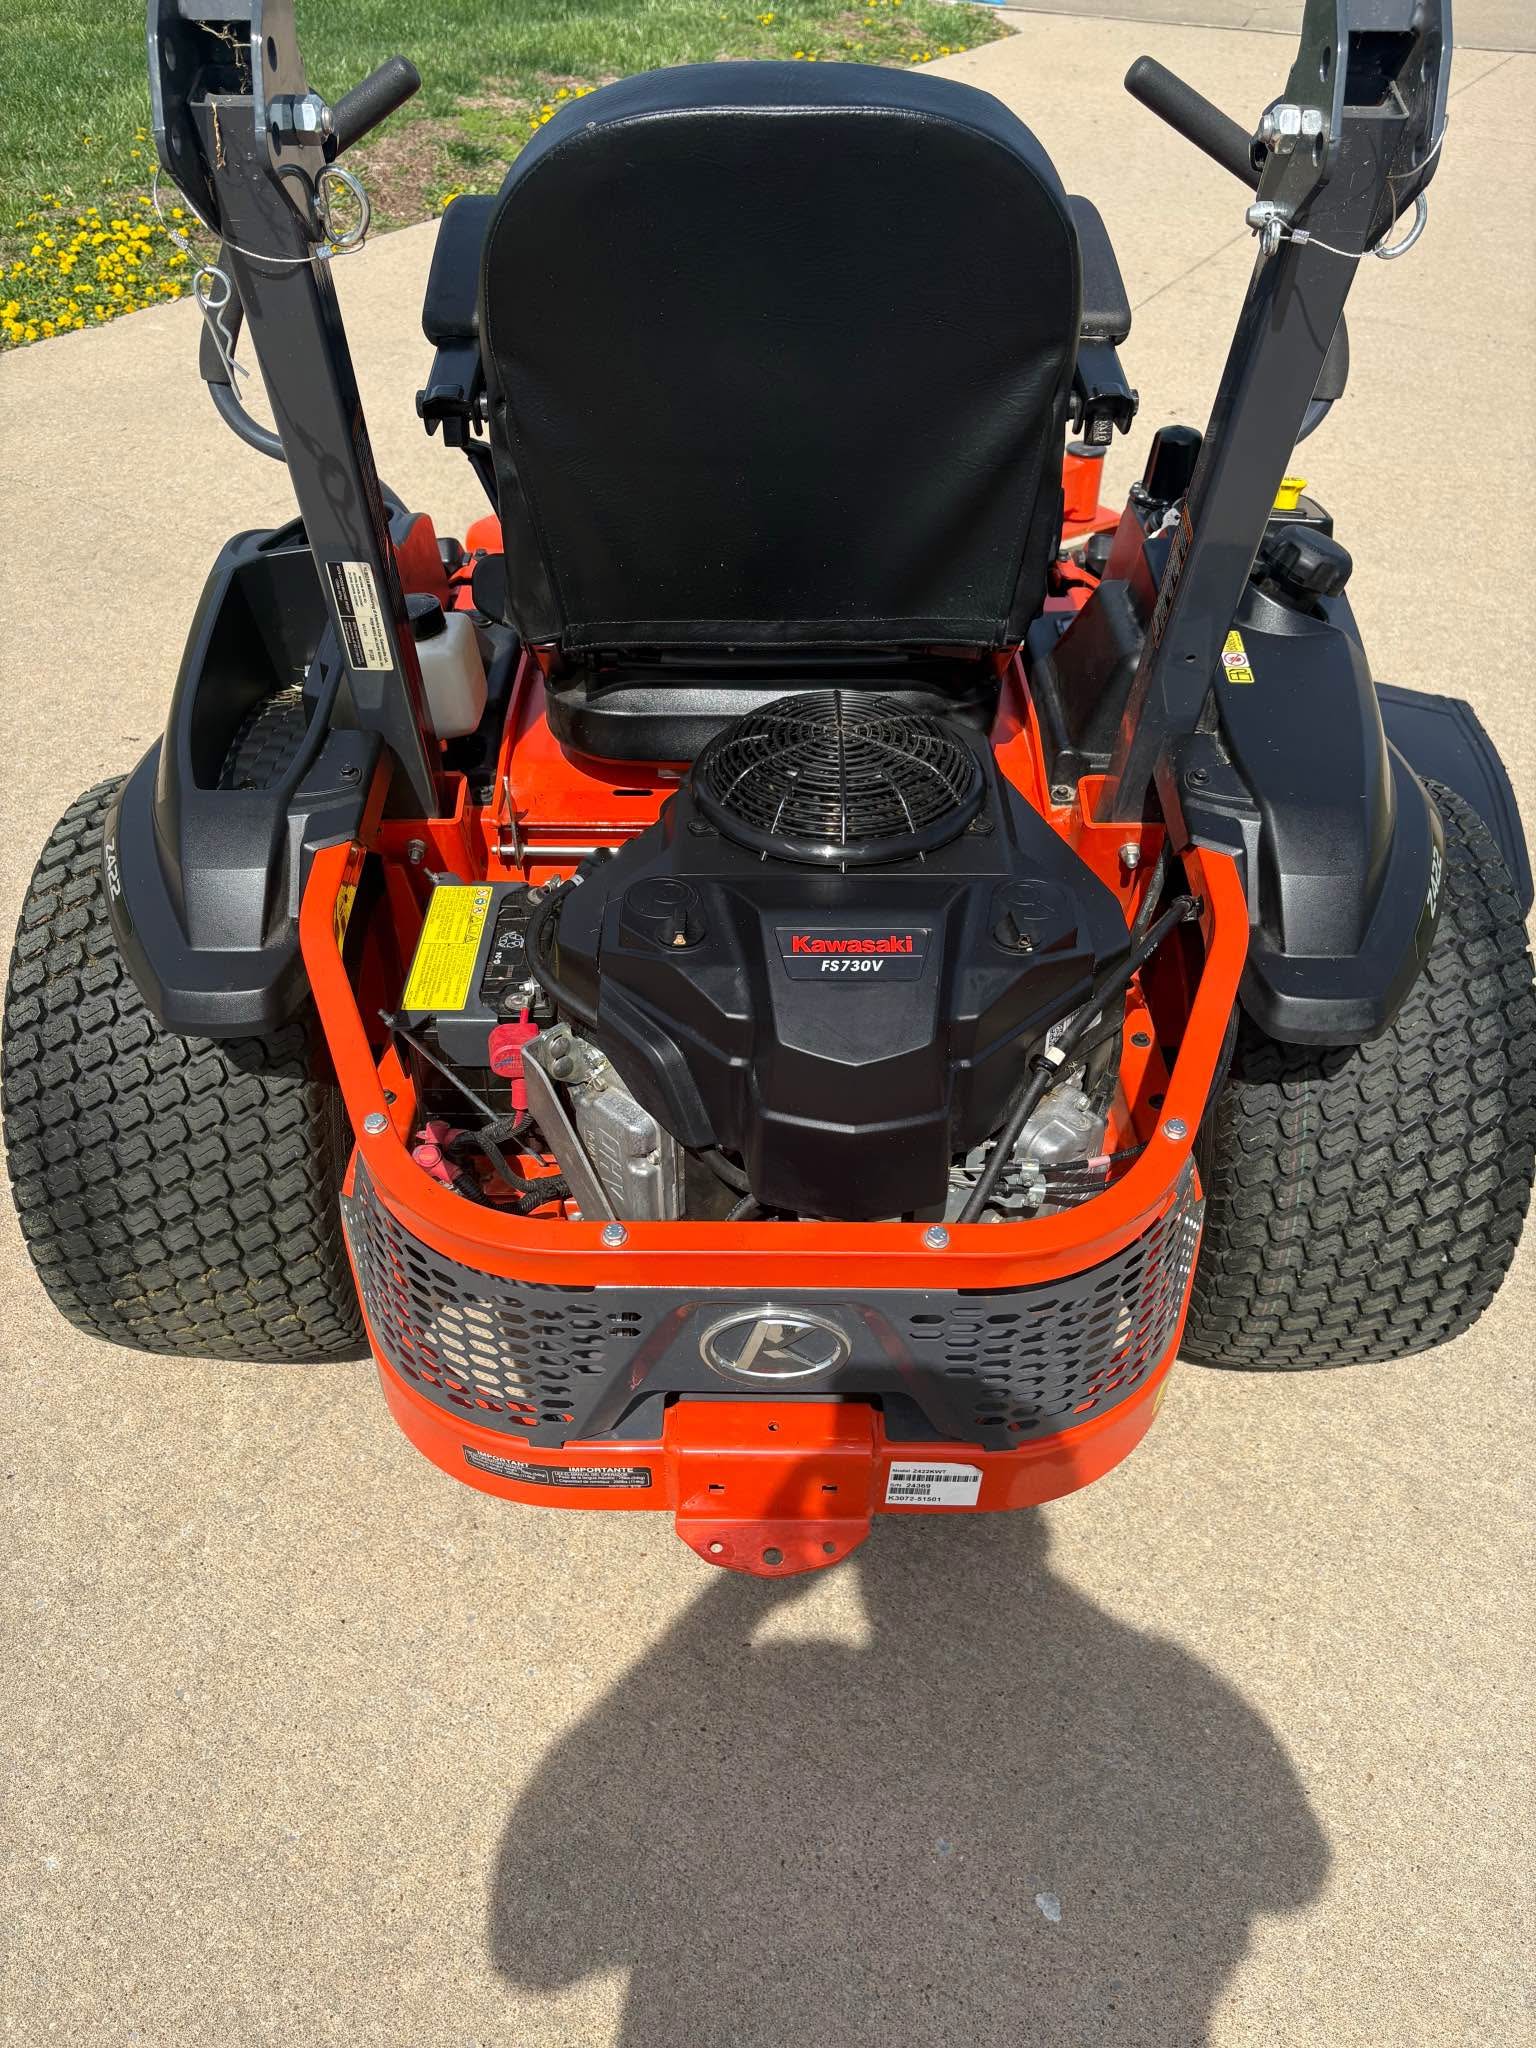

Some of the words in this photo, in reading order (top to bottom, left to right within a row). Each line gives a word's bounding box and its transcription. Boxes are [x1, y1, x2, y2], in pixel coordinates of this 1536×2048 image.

[105, 836, 121, 902] Z422
[1427, 845, 1442, 919] Z422
[792, 936, 912, 952] Kawasaki
[821, 960, 883, 972] FS730V
[477, 1450, 529, 1468] IMPORTANT
